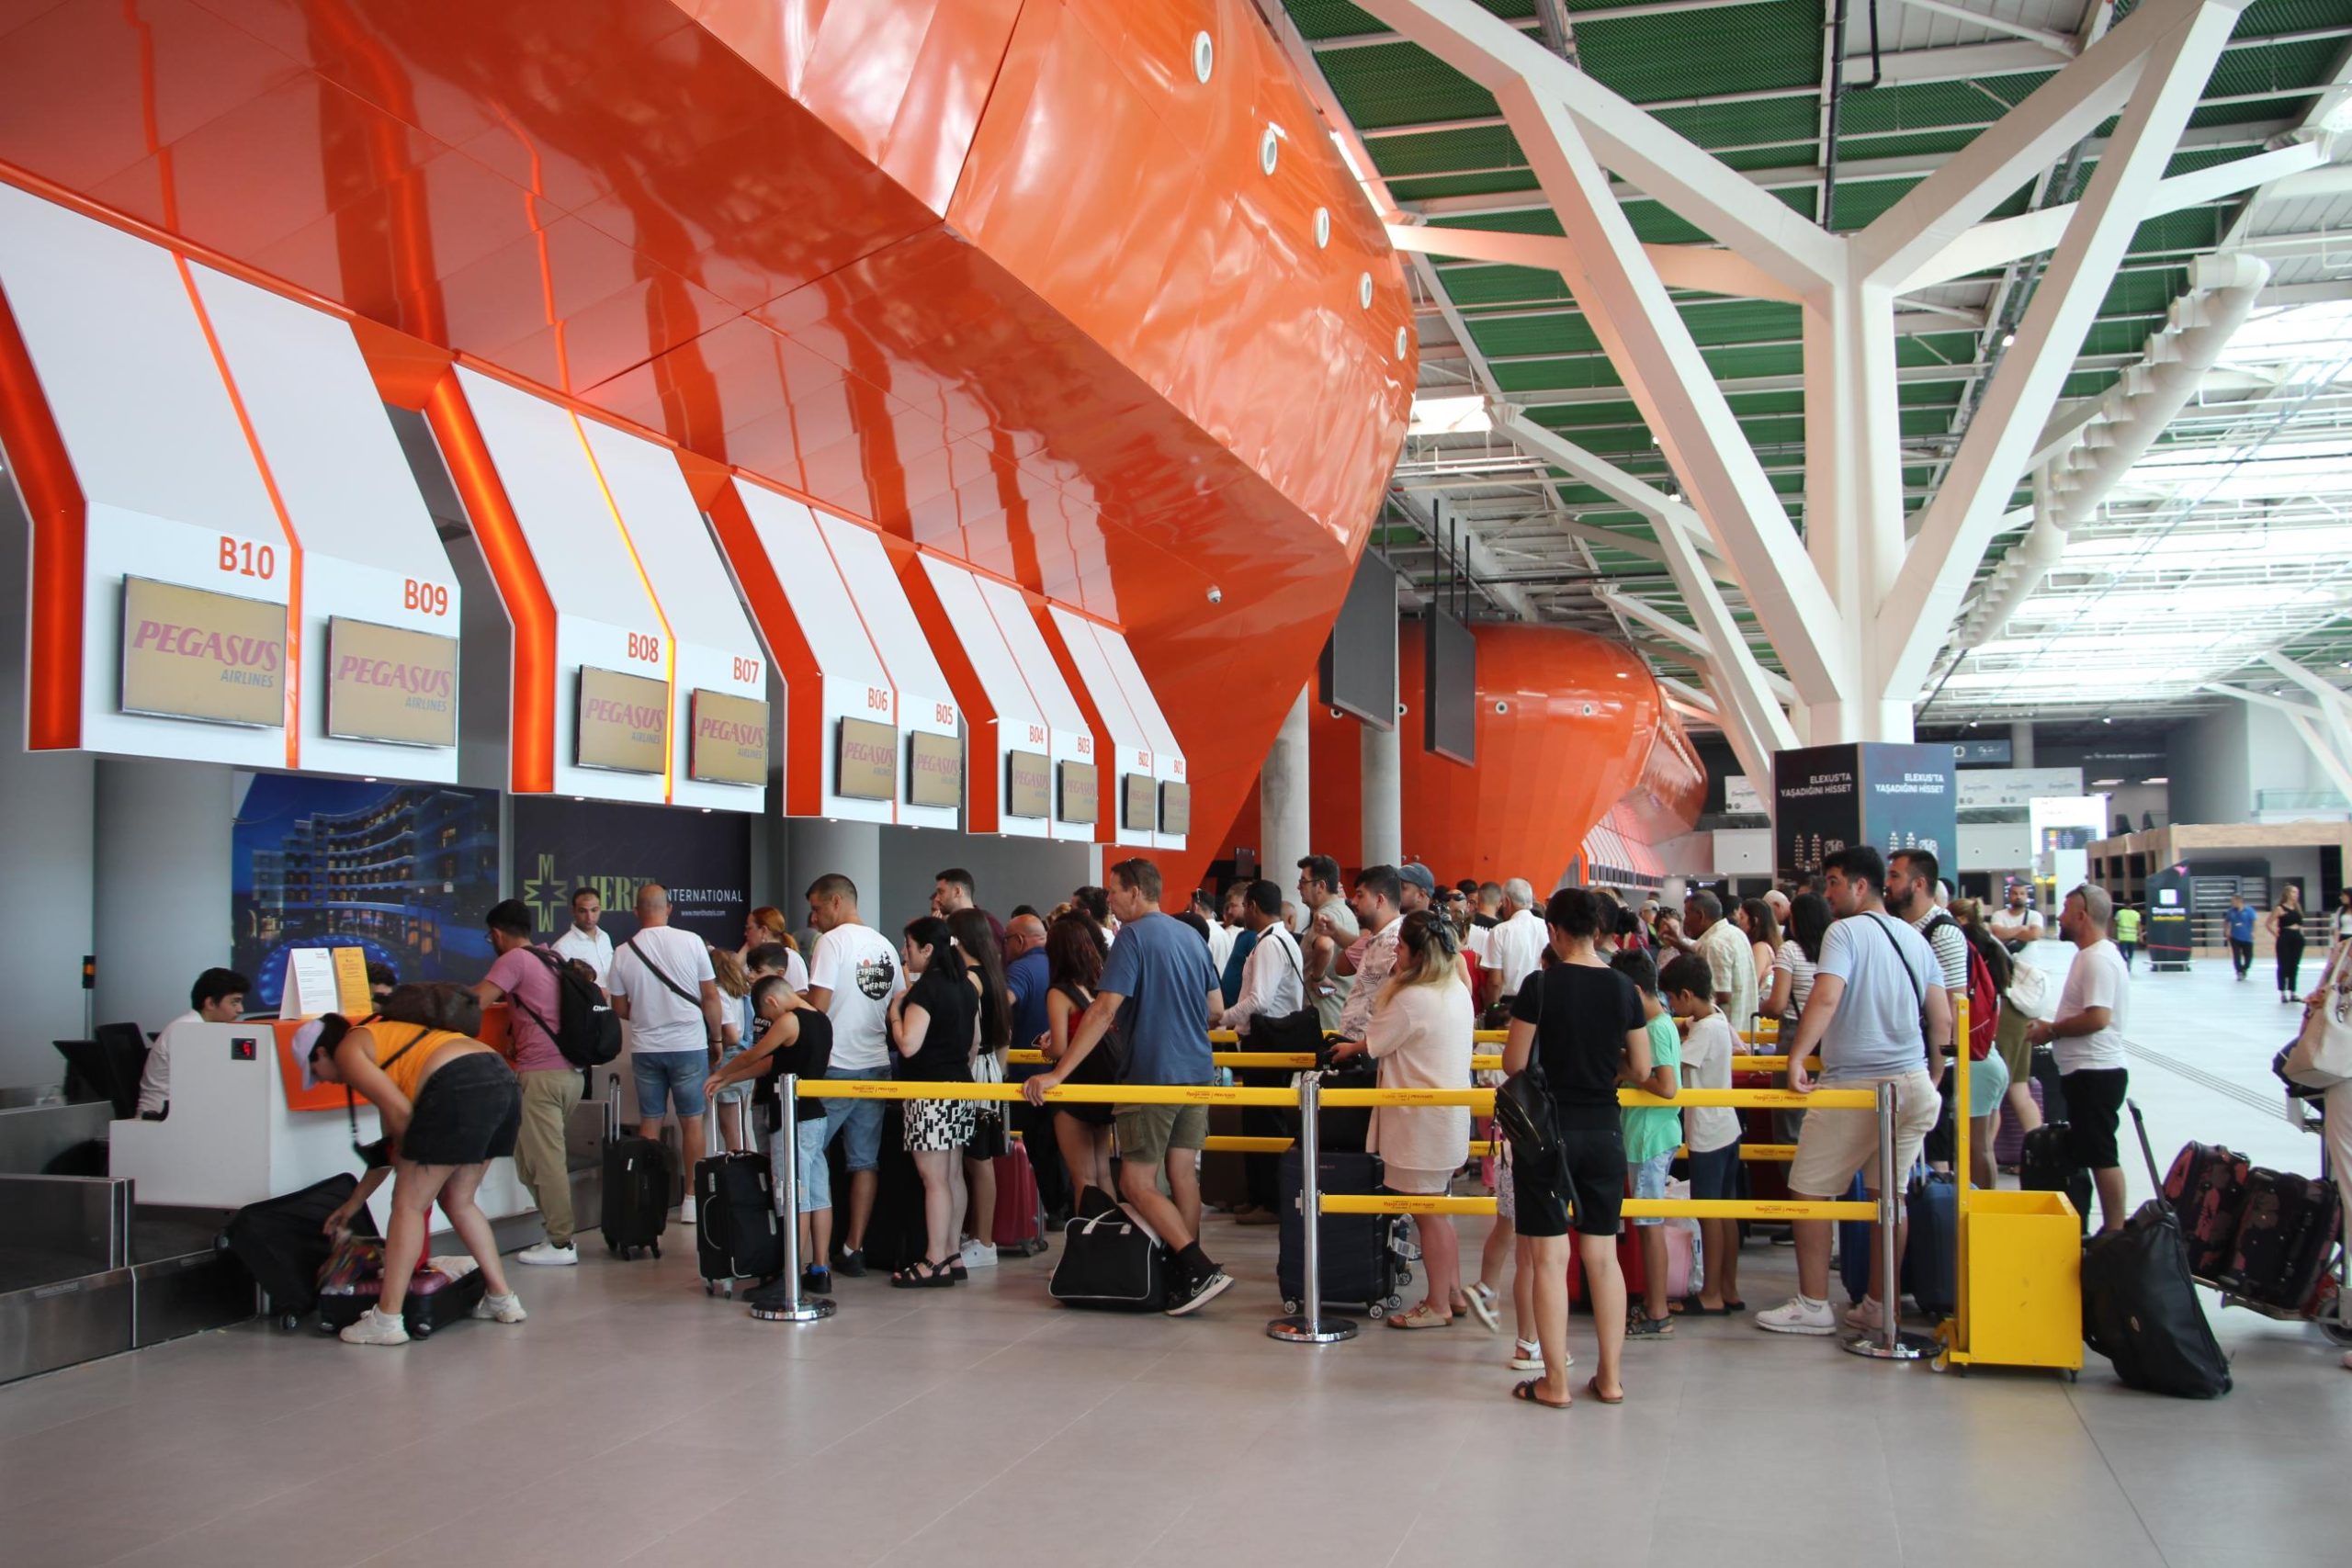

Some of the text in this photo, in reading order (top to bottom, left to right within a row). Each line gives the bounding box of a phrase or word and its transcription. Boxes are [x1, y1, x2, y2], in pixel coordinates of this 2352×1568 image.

[219, 536, 275, 580] B10
[404, 579, 448, 616] B09
[133, 619, 281, 671] PEGASUS
[628, 631, 659, 663] B08
[220, 669, 274, 688] AIRLINES
[337, 655, 451, 698] PEGASUS
[733, 656, 759, 683] B07
[405, 696, 447, 712] AIRLINES
[867, 687, 888, 712] B06
[585, 697, 665, 732] PEGASUS
[935, 703, 954, 725] B05
[699, 717, 765, 749] PEGASUS
[1029, 725, 1044, 744] B04
[1077, 736, 1091, 754] B03
[845, 741, 895, 767] PEGASUS
[917, 753, 959, 776] PEGASUS
[1809, 773, 1852, 784] ELEXUS'TA
[1904, 773, 1944, 783] ELEXUS'TA
[666, 888, 743, 903] NTERNATIONAL
